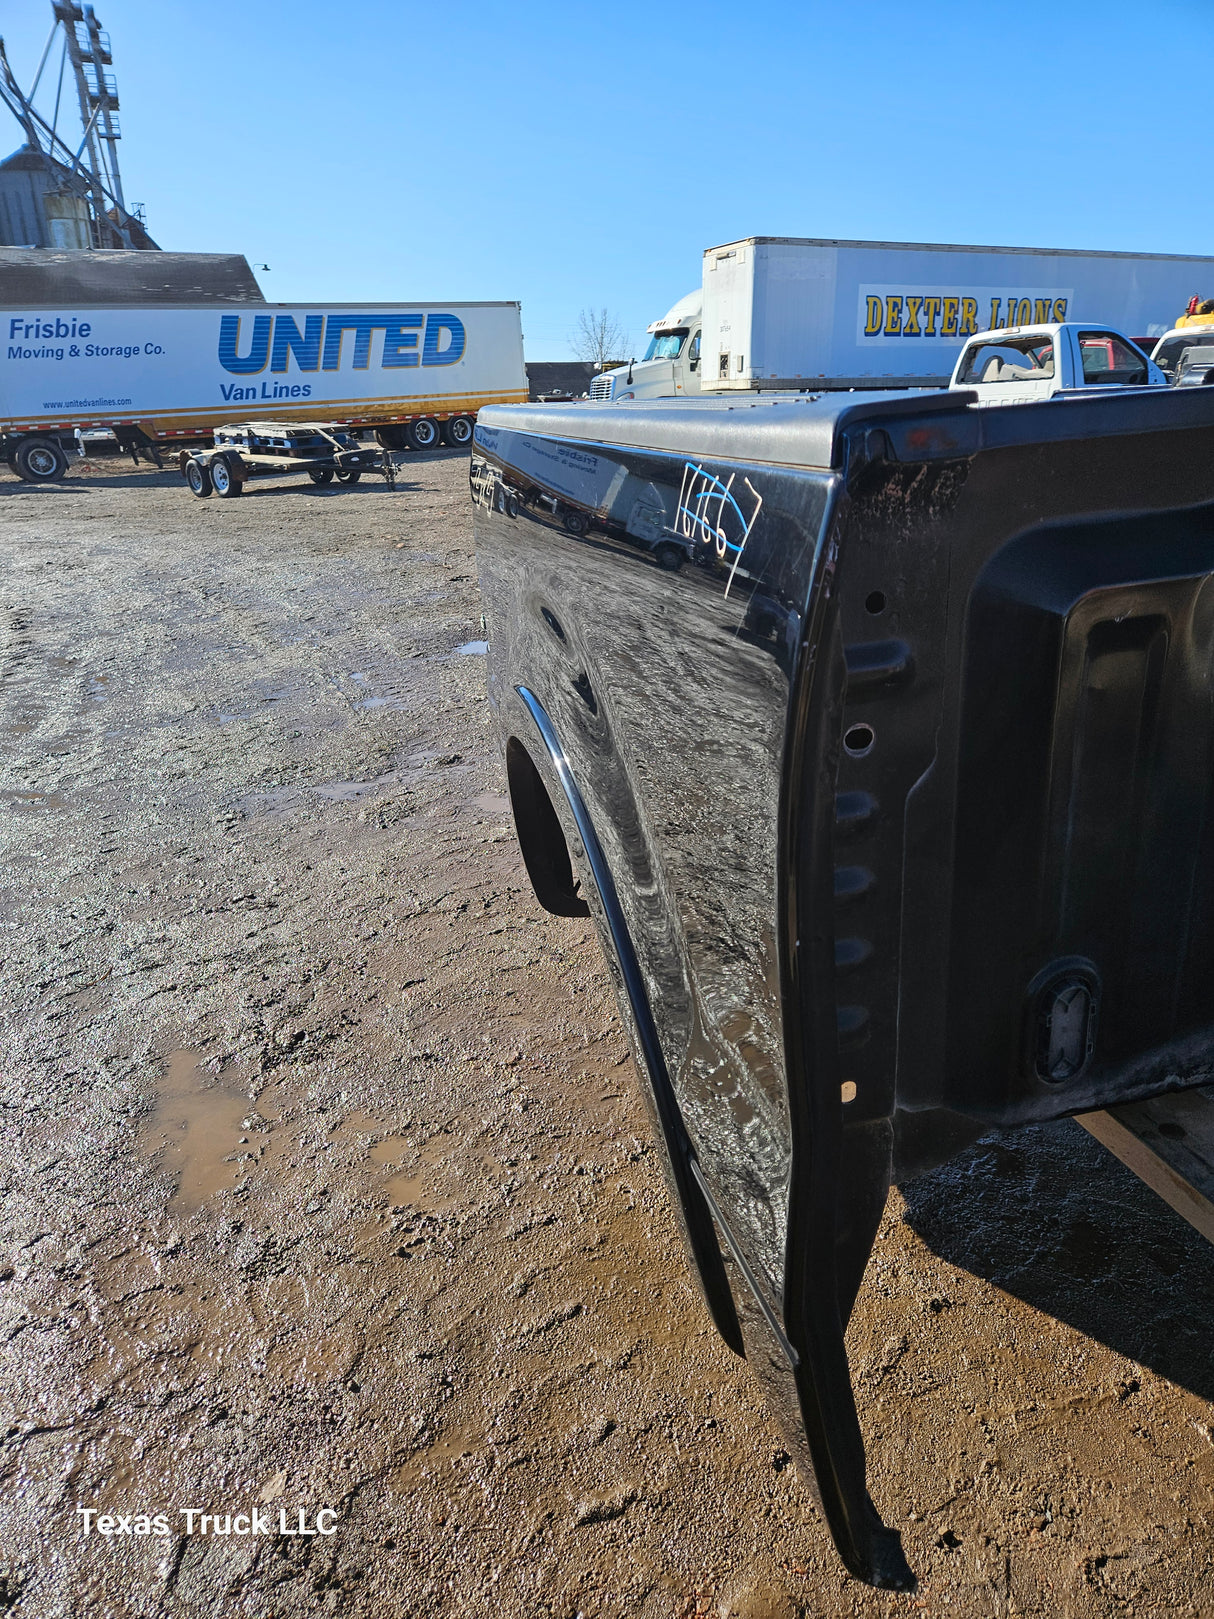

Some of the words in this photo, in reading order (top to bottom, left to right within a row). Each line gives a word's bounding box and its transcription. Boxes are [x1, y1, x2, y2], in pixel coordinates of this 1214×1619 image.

[864, 295, 979, 337] DEXTER
[988, 298, 1068, 332] LIONS
[9, 317, 92, 340] Frisbie
[7, 345, 64, 361] Moving
[68, 344, 81, 358] &
[84, 343, 140, 359] Storage
[144, 342, 166, 355] Co.
[218, 313, 468, 376] UNITED
[219, 383, 257, 401] Van
[261, 381, 312, 399] Lines
[42, 397, 133, 409] www.unitedvanlines.com
